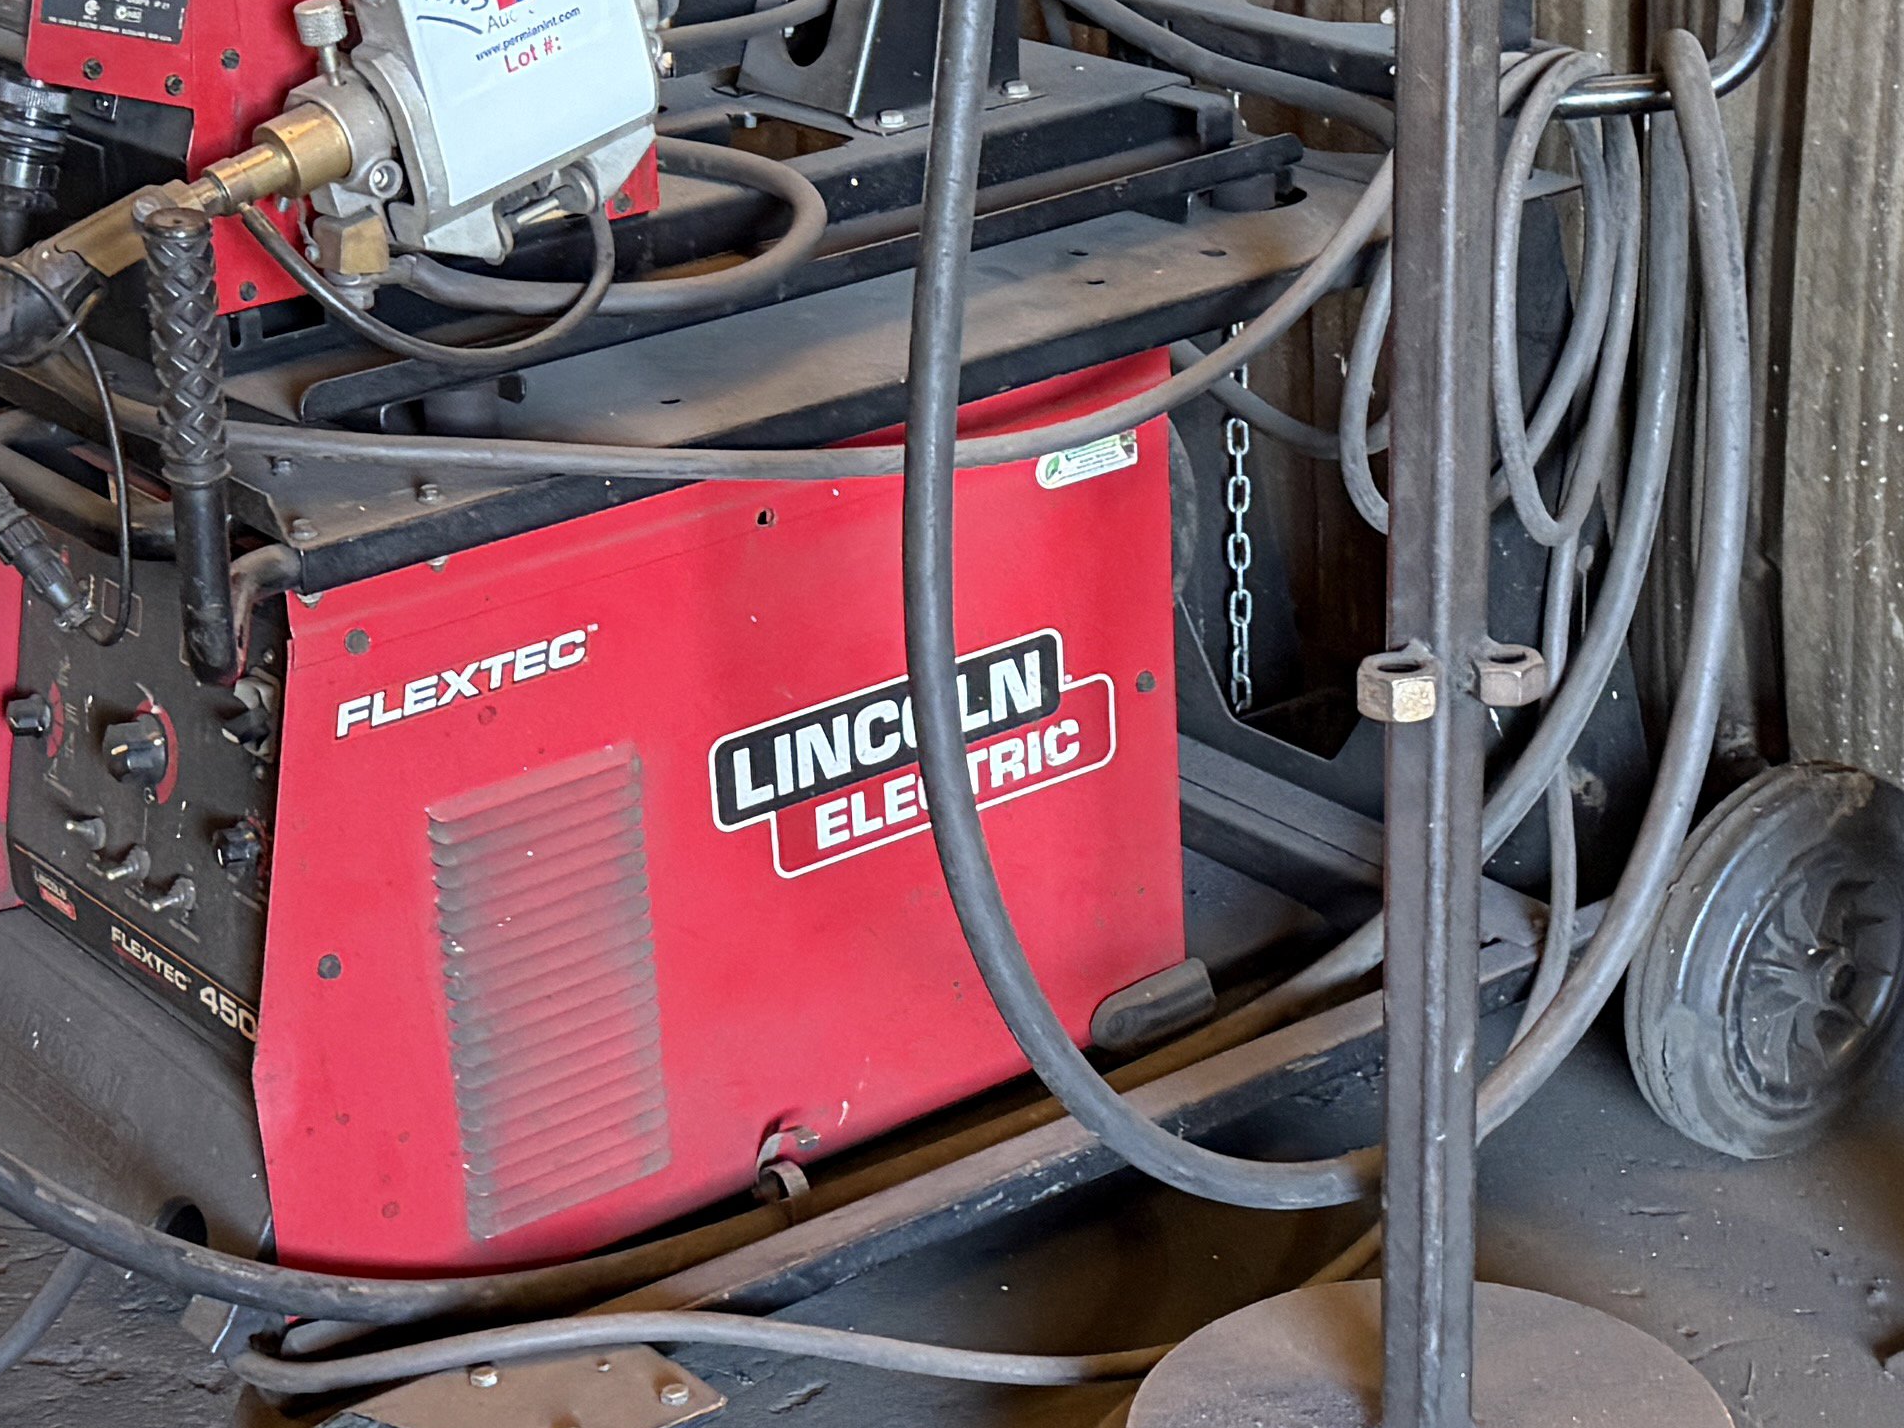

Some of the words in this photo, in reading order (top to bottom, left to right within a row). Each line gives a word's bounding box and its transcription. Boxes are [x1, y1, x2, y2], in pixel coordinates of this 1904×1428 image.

[503, 43, 539, 74] Lot
[543, 35, 562, 56] #:
[335, 629, 587, 739] FLEXTEC
[732, 649, 1043, 811] LINCLN
[814, 718, 1081, 851] ELETRIC
[110, 925, 189, 992] FLEXTEC
[199, 985, 258, 1043] 450
